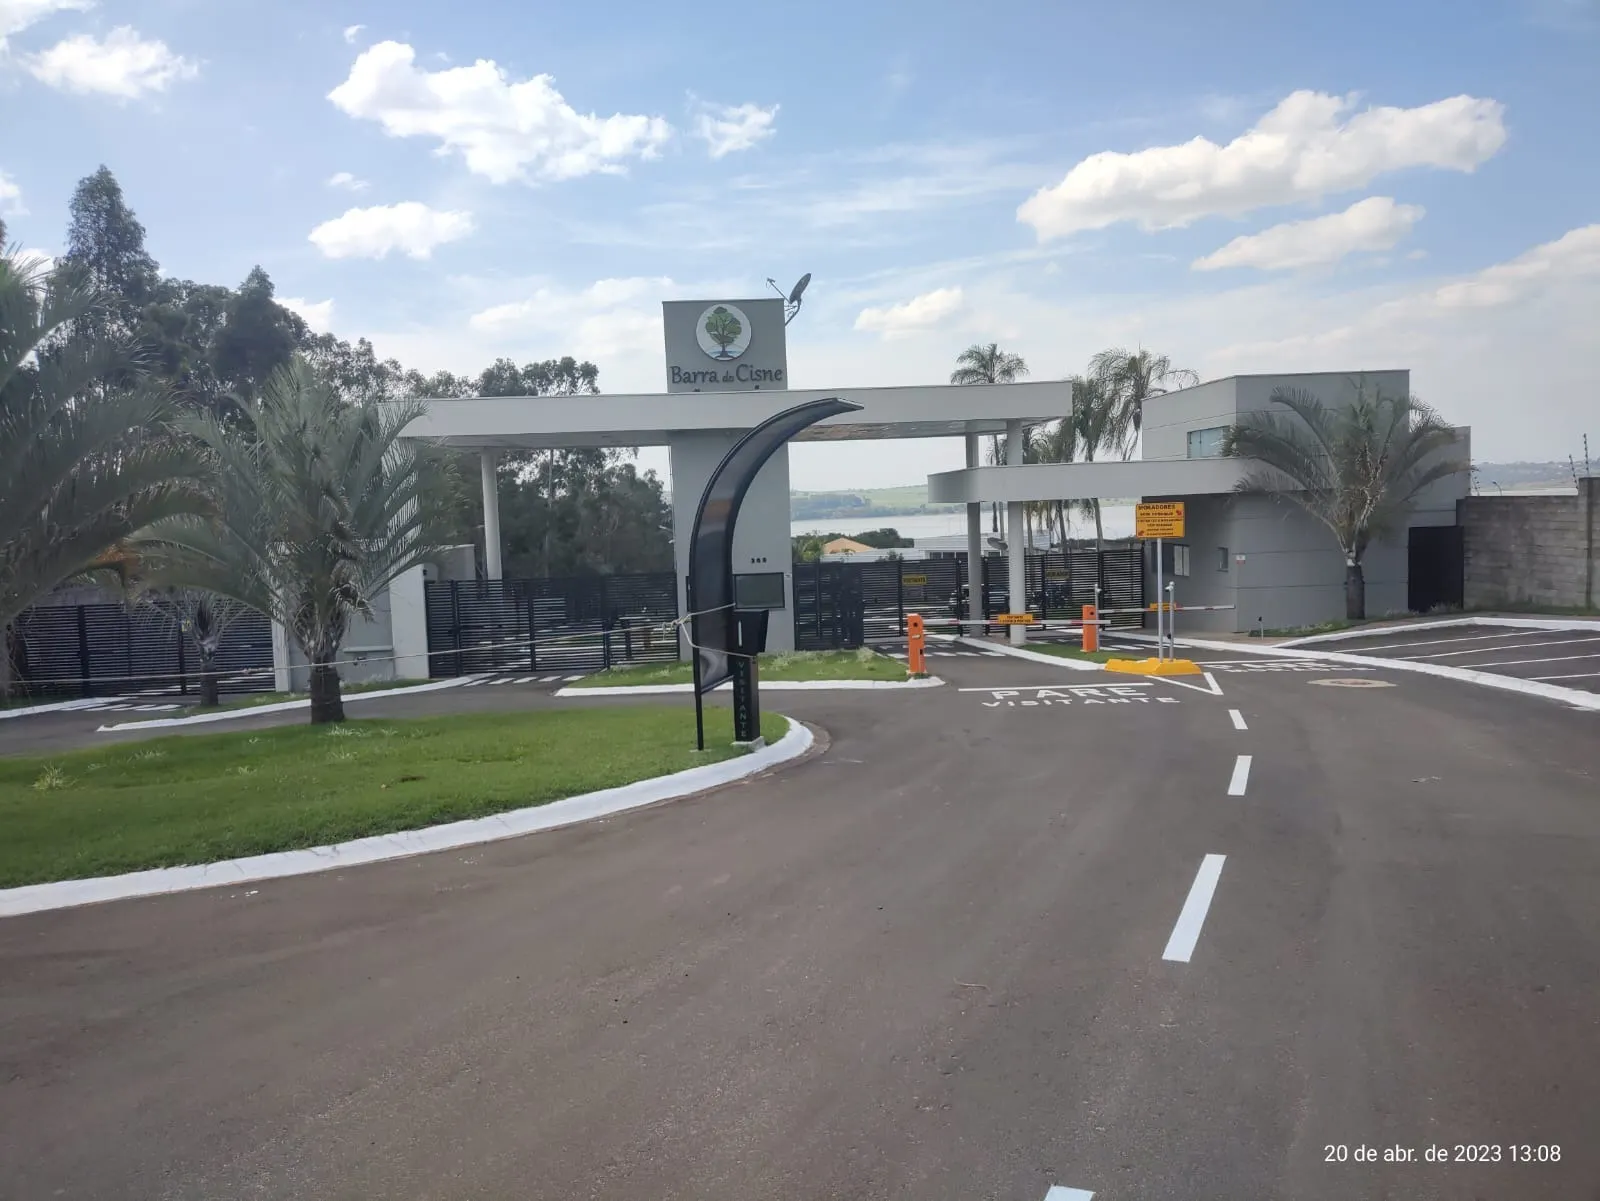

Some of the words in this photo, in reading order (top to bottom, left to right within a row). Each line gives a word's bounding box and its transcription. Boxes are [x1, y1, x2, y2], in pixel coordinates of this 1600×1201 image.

[669, 365, 719, 384] Barra
[736, 363, 783, 383] Cisne
[991, 687, 1147, 700] PARE
[981, 697, 1180, 707] VISITANTE
